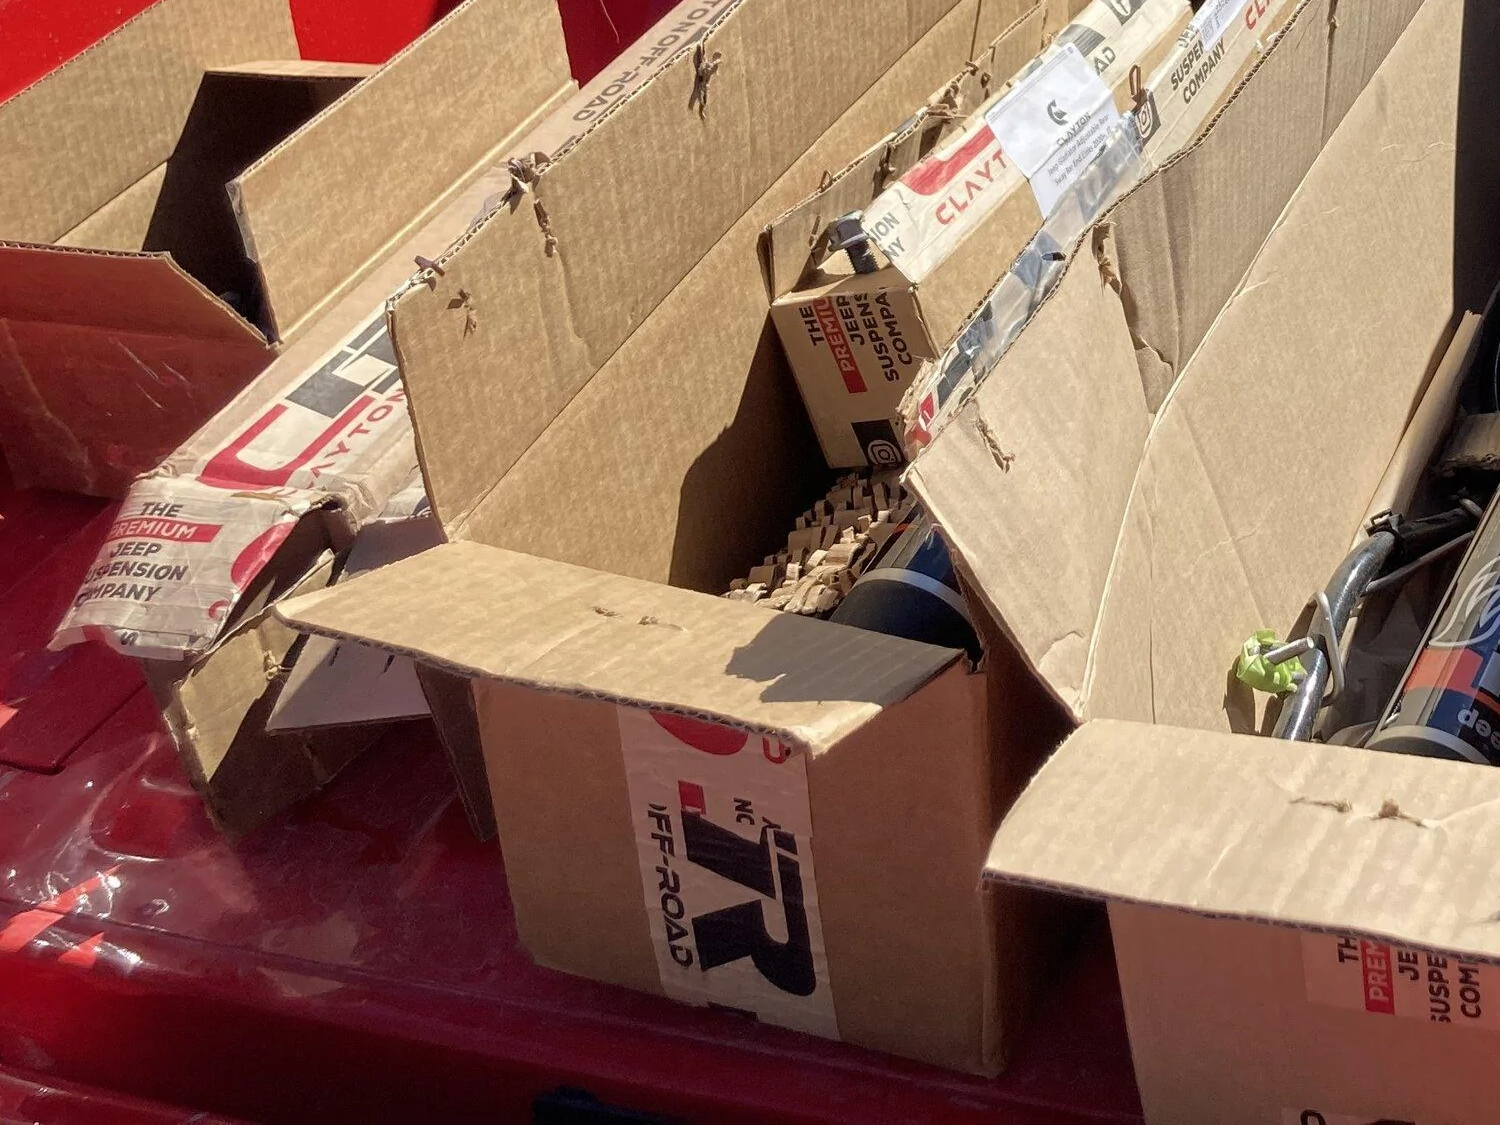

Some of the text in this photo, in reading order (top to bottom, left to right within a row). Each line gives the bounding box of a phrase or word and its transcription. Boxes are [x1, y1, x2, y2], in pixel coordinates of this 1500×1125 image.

[1183, 37, 1225, 104] COMPANY
[1055, 111, 1092, 147] CLAYTON
[799, 305, 825, 347] THE
[836, 295, 865, 346] JEEP
[140, 501, 183, 518] THE
[110, 542, 161, 557] JEEP
